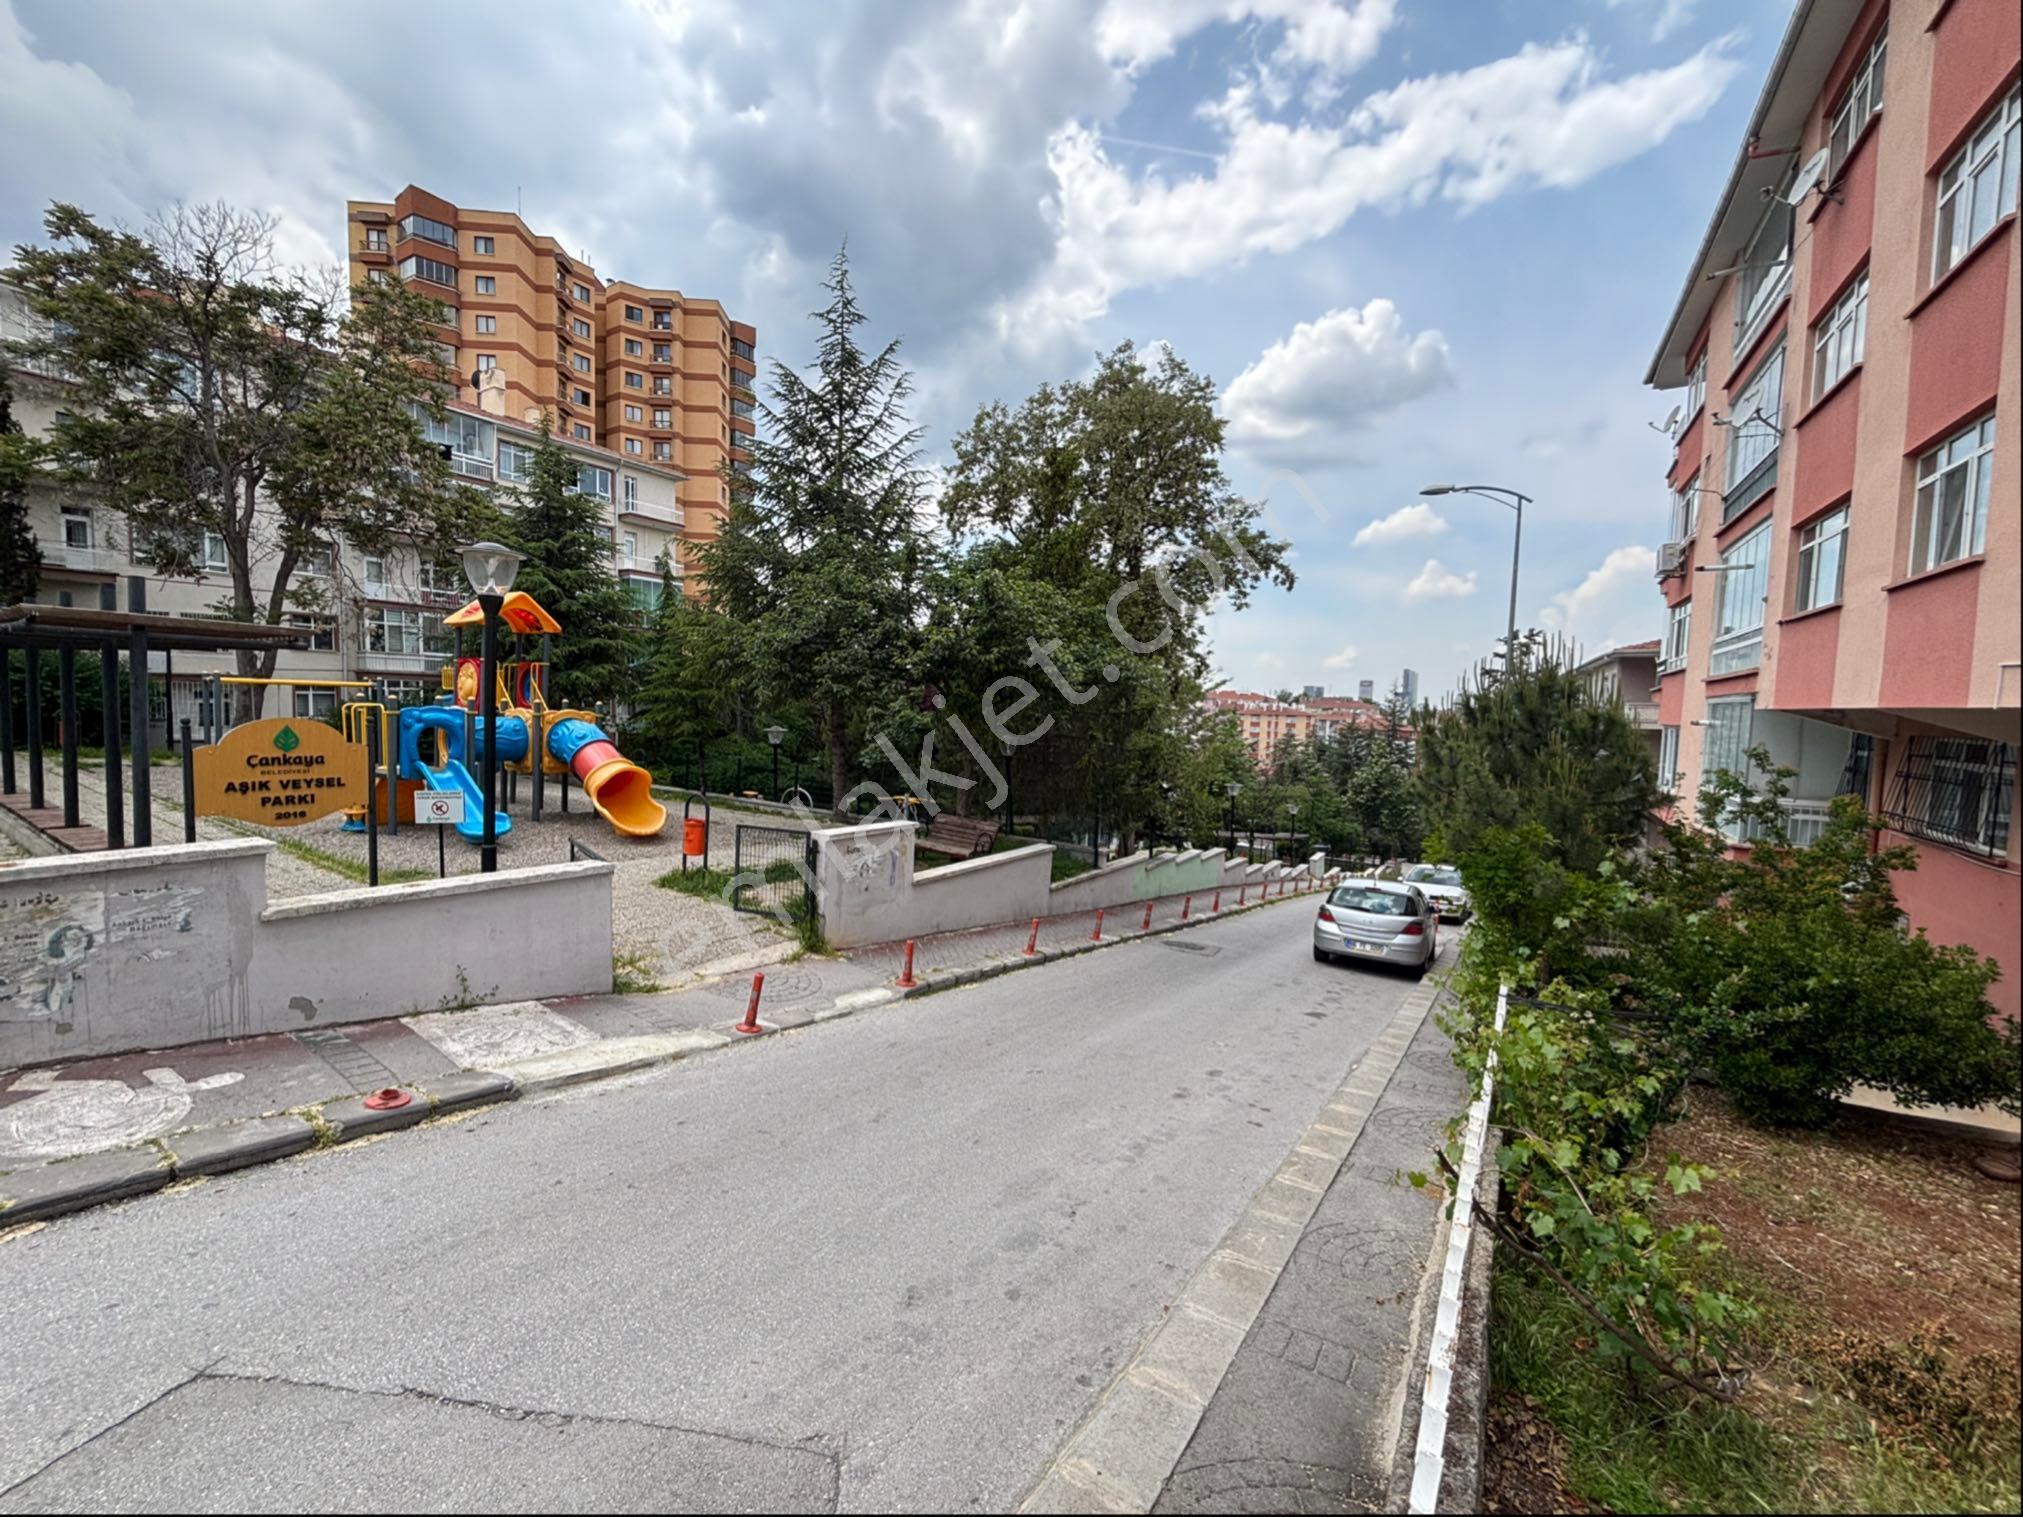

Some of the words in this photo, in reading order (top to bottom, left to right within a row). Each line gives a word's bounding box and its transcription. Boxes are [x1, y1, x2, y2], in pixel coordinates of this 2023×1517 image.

[246, 752, 325, 768] Çankaya
[224, 780, 271, 795] AŞIK
[279, 777, 346, 790] VEYSEL
[261, 793, 315, 807] PARKI
